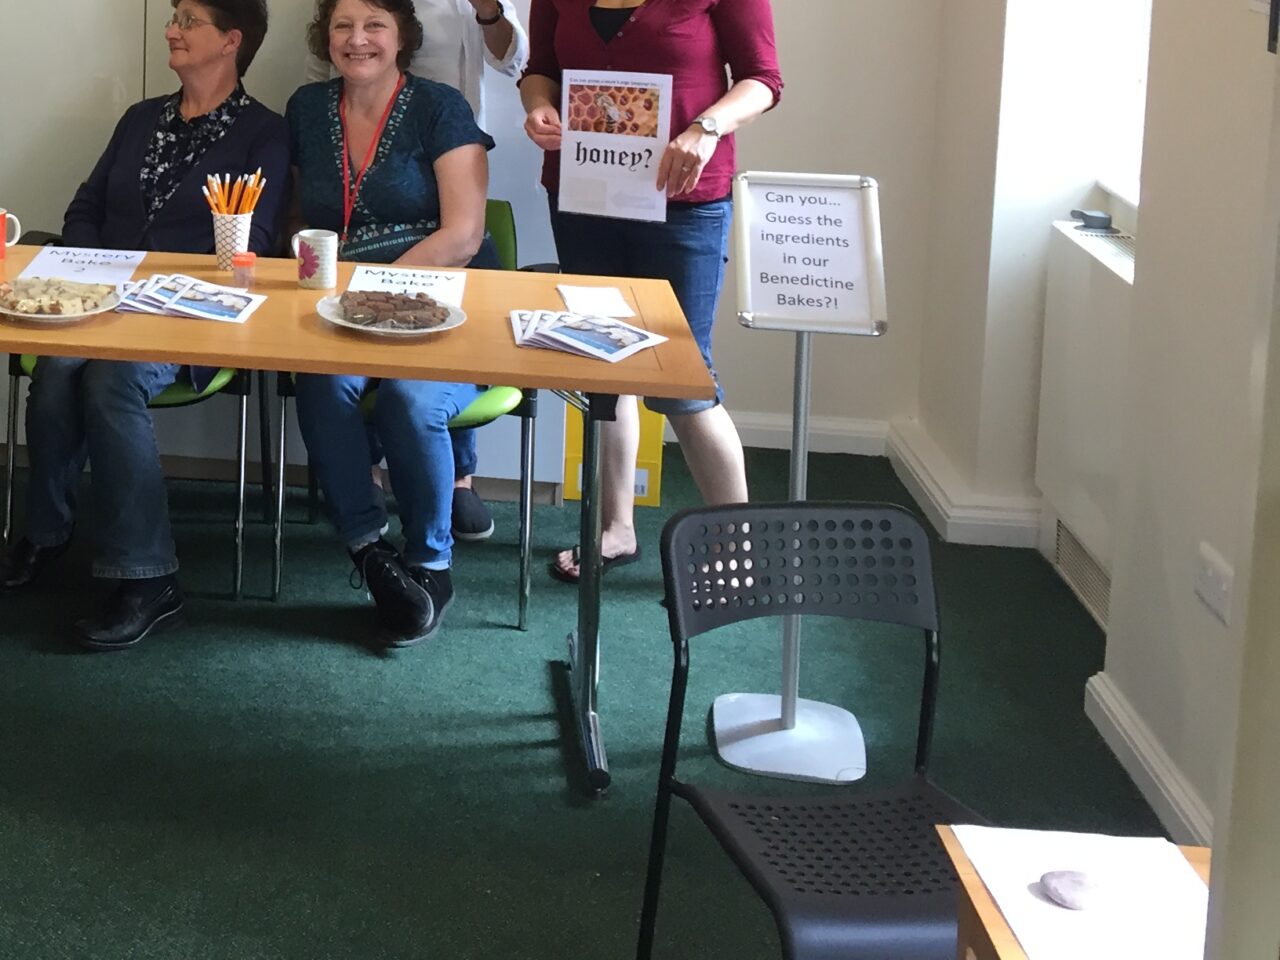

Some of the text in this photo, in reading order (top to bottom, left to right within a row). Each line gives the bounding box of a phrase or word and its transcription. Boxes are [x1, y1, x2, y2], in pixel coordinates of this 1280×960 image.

[575, 141, 653, 172] honey?
[765, 191, 841, 207] Can you...
[765, 212, 843, 227] Guess the
[761, 230, 850, 248] ingredients
[49, 250, 135, 259] Mystery
[783, 252, 830, 268] in our
[365, 269, 455, 280] Mystery
[381, 278, 434, 286] Bake
[760, 272, 855, 290] Benedictine
[777, 293, 839, 309] Bakes?!
